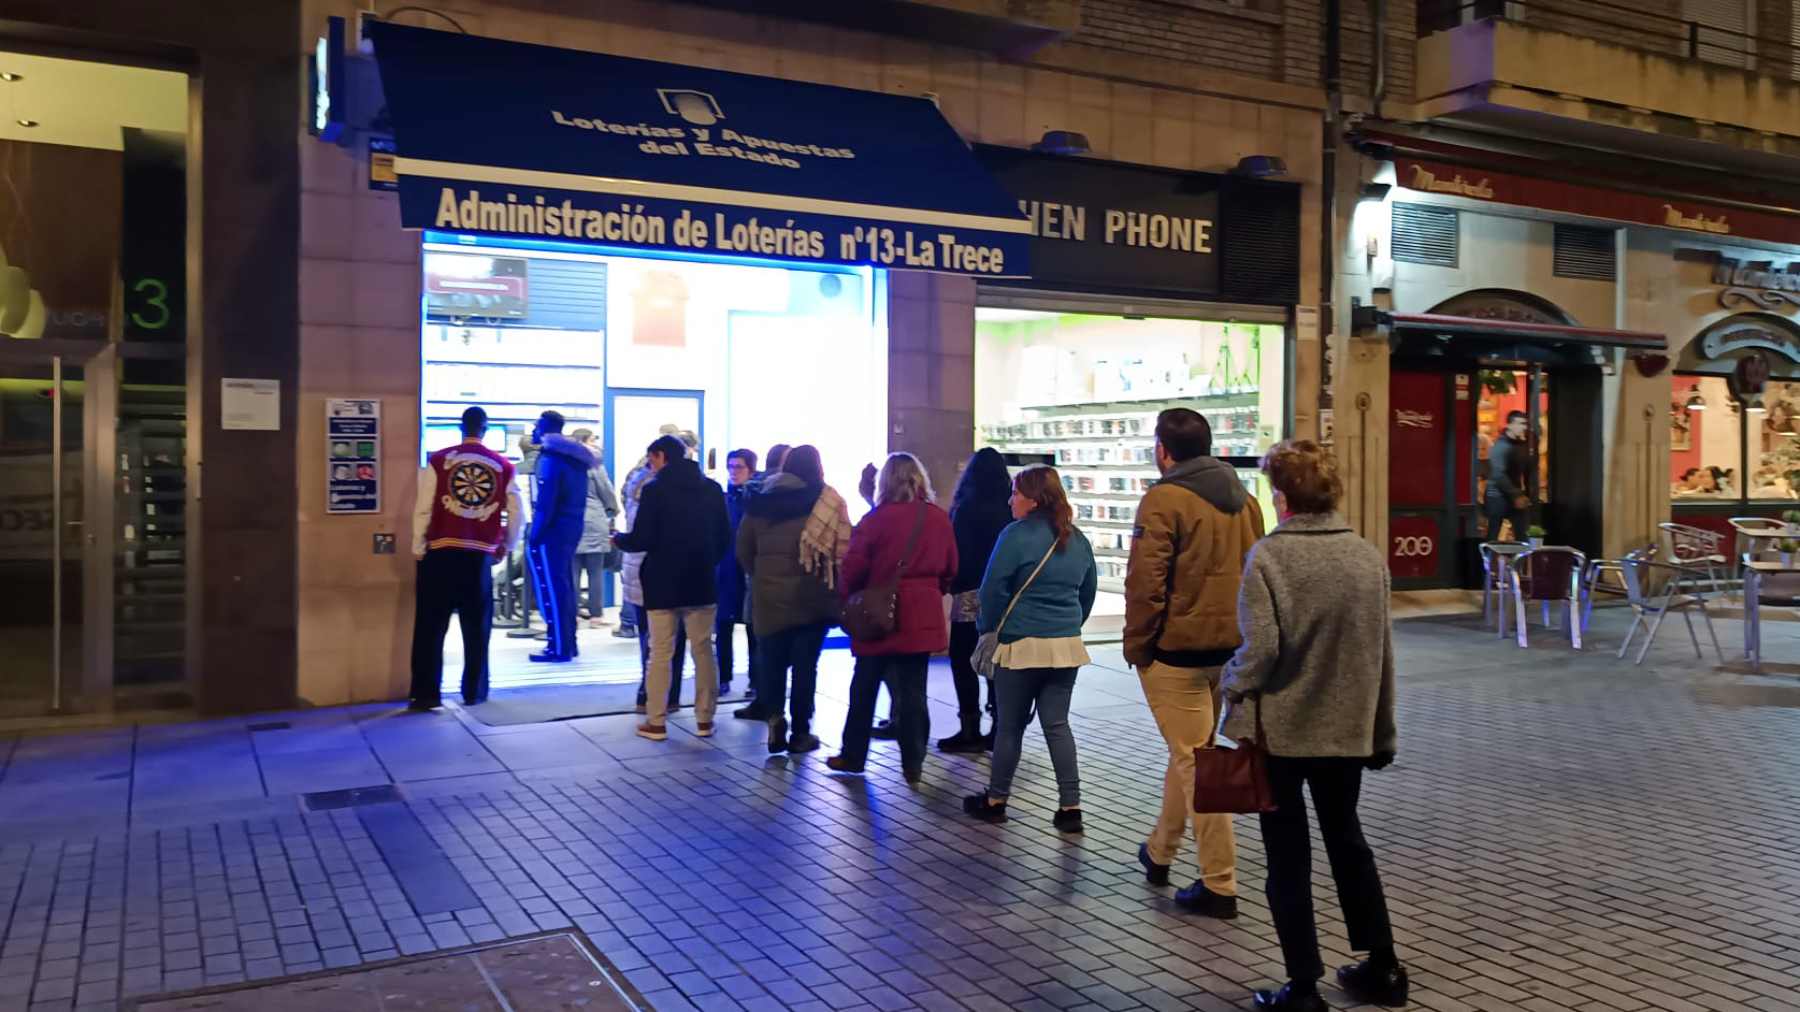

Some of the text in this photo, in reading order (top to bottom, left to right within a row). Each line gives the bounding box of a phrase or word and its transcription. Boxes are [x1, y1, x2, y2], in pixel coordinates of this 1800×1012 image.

[639, 140, 801, 169] del Estado
[721, 128, 855, 159] Apuestas
[435, 187, 665, 245] Administración
[673, 210, 709, 249] de
[715, 213, 825, 258] Loterías
[938, 233, 1005, 273] Trece
[1104, 209, 1213, 253] PHONE
[132, 278, 169, 329] 3
